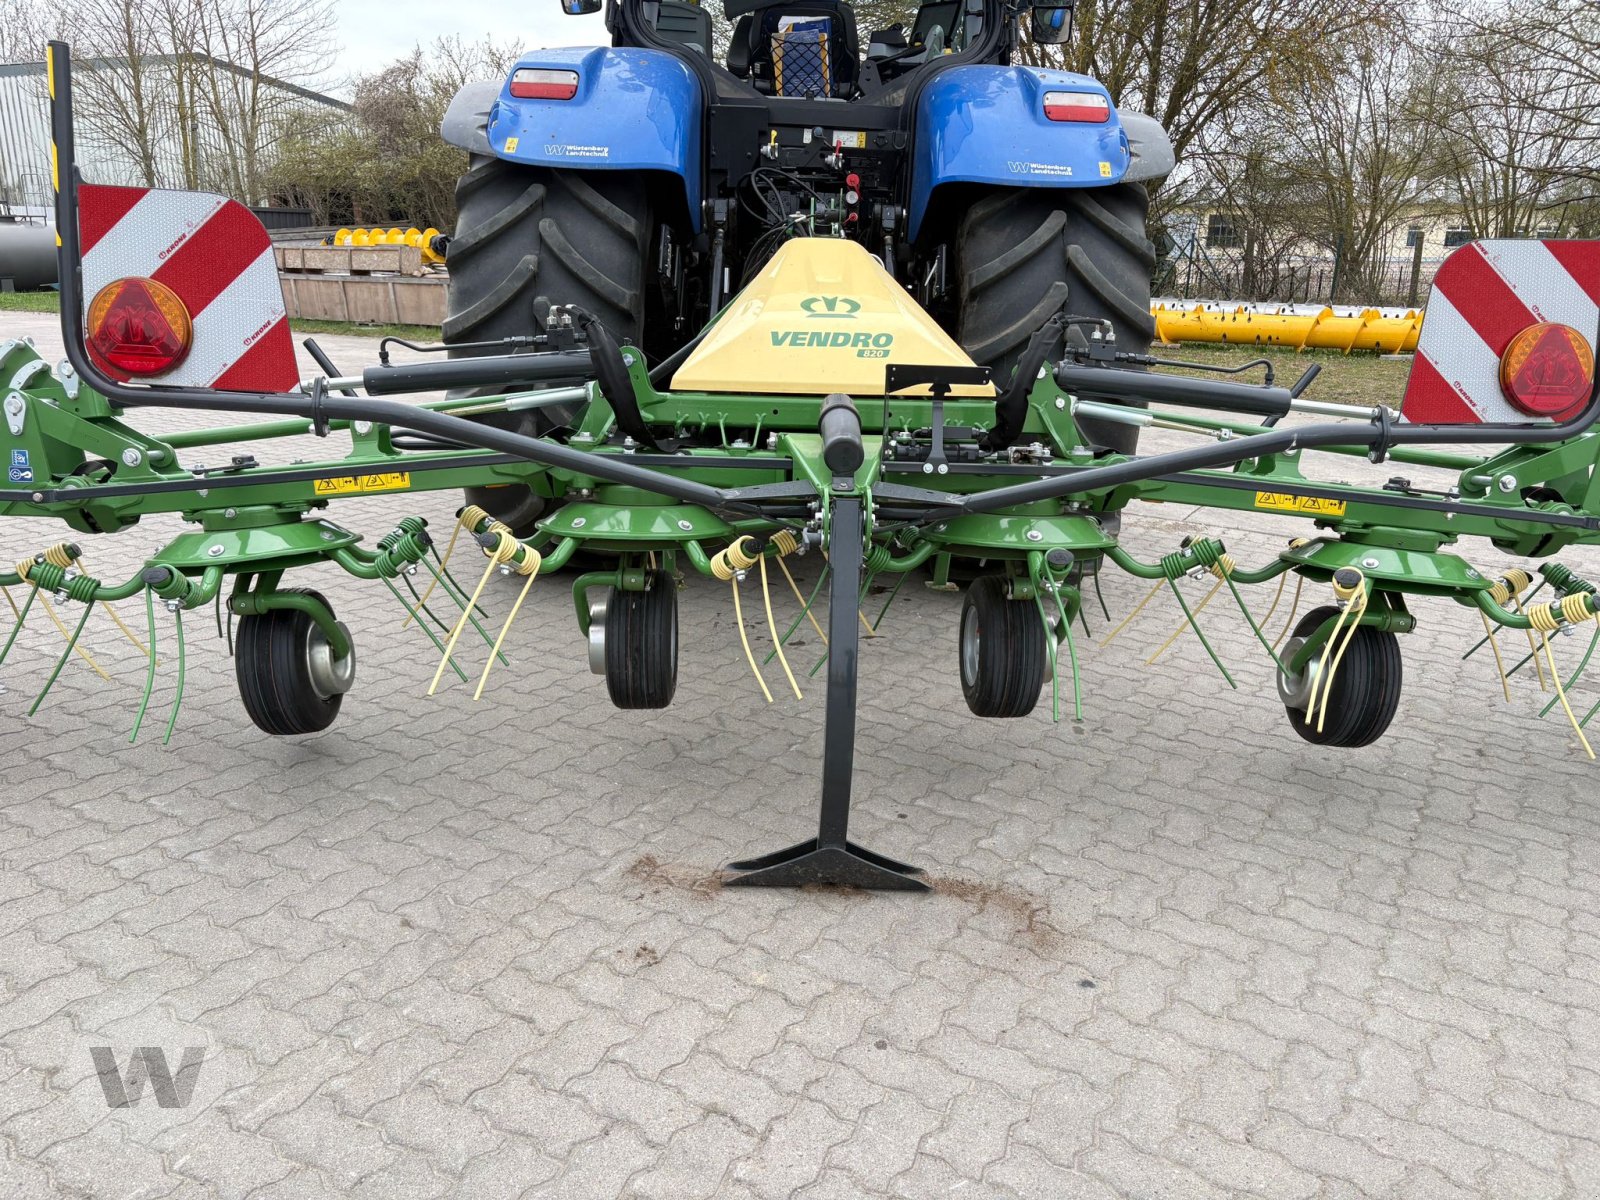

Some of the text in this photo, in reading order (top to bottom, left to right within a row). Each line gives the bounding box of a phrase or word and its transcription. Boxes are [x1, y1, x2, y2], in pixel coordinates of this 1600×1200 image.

[1031, 168, 1072, 176] Landtechnik
[166, 233, 186, 254] KRONE
[250, 320, 272, 341] KRONE
[770, 331, 893, 348] VENDRO
[1458, 388, 1477, 408] KRONE
